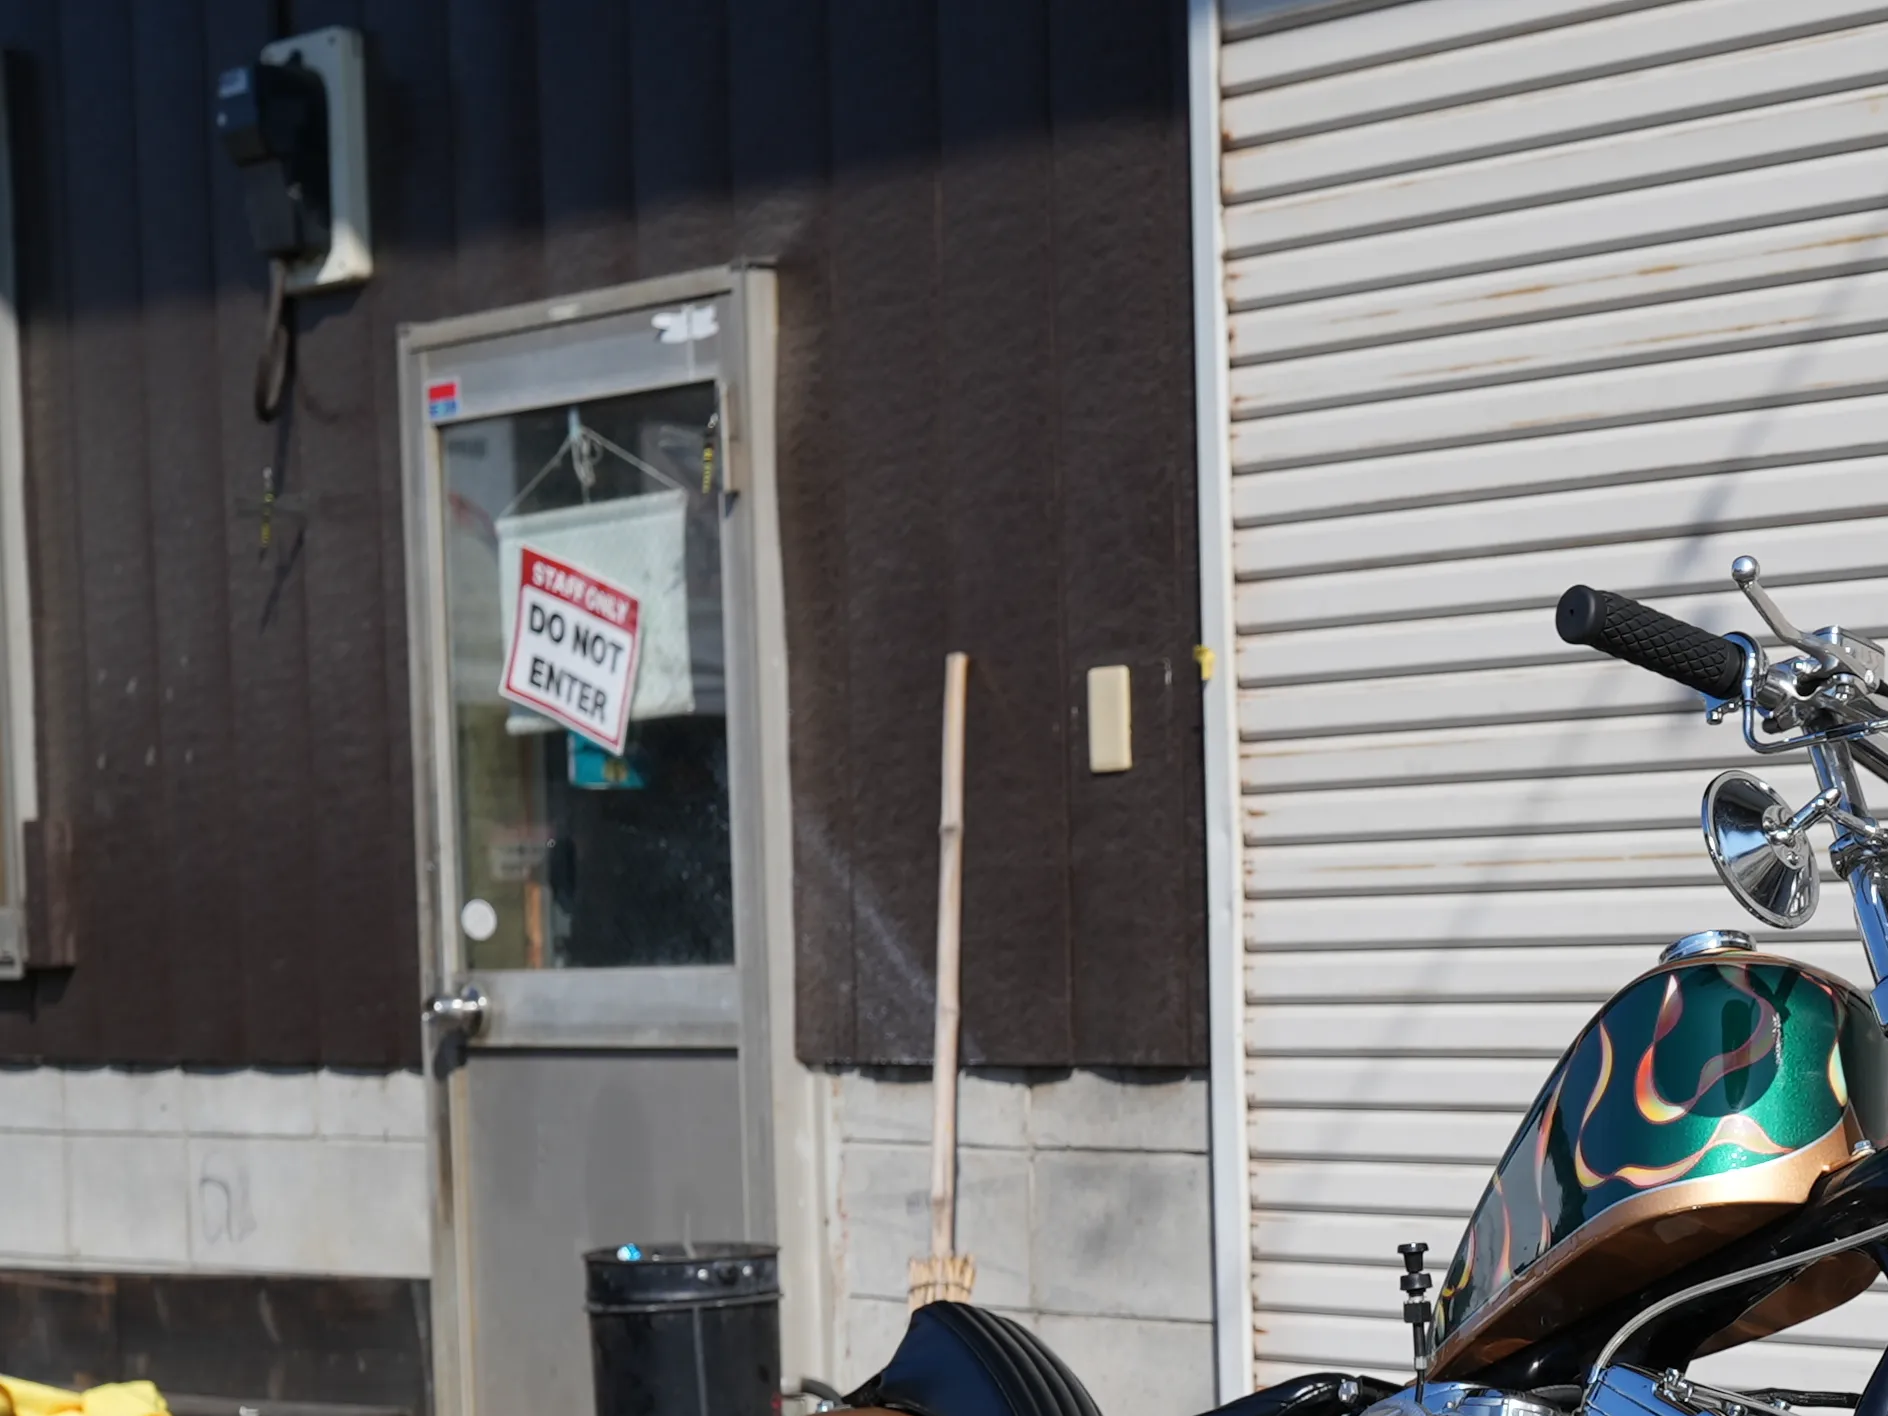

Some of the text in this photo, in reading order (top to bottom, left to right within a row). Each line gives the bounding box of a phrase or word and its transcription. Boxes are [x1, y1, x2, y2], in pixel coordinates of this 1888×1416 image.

[531, 561, 630, 623] STAFF ONLY
[528, 603, 624, 674] DO NOT
[528, 656, 608, 723] ENTER
